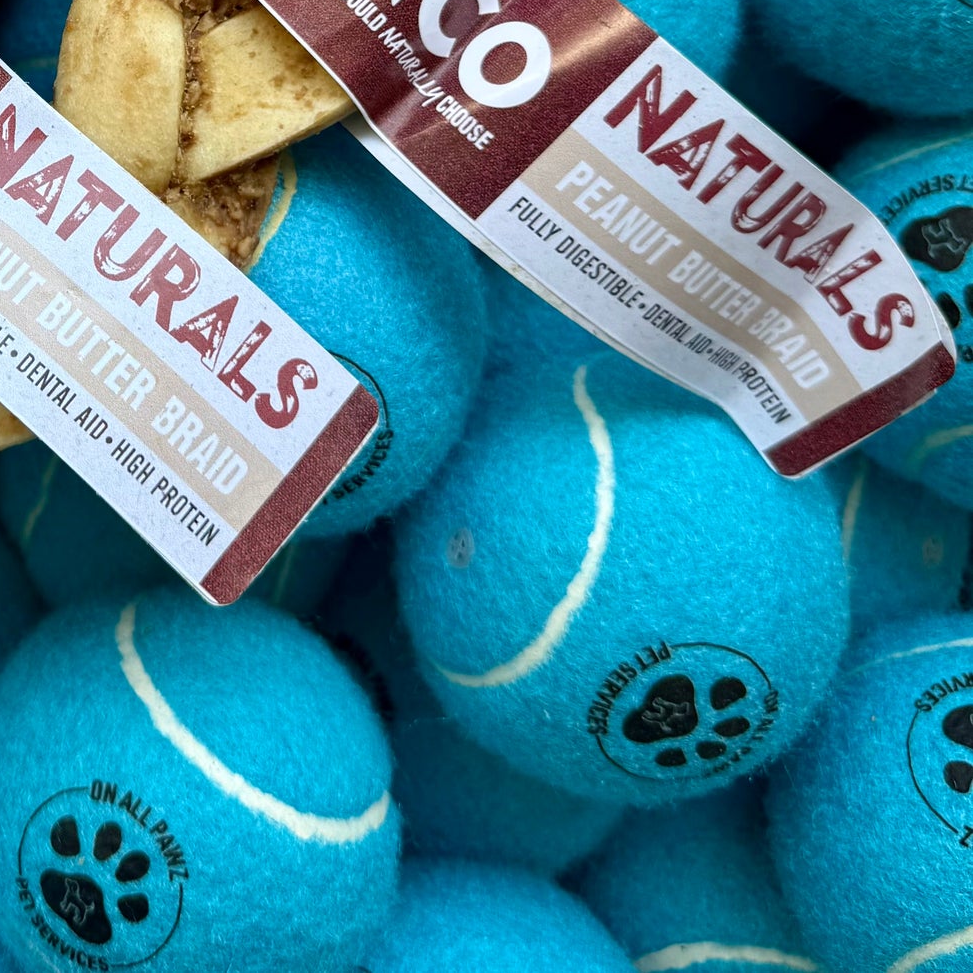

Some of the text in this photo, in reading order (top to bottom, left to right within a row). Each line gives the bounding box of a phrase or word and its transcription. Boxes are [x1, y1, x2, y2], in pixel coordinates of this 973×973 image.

[378, 27, 444, 107] NATURALLY
[436, 95, 496, 151] CHOOSE
[604, 64, 915, 351] NATURALS
[508, 196, 792, 423] FULLY DIGESTIBLE DENTAL AID HIGH PROTEIN
[555, 161, 830, 389] PEANUT BUTTER BRAID
[16, 352, 82, 416] DENTAL
[74, 406, 109, 443] AID
[111, 438, 152, 485] HIGH
[152, 479, 222, 548] PROTEIN
[38, 289, 158, 412] BUTTER
[151, 394, 250, 496] BRAID
[332, 429, 394, 499] SERVICES
[588, 640, 671, 735] PET SERVICES
[914, 672, 973, 712] RVICES
[90, 779, 189, 882] ON ALL PAWZ
[16, 877, 109, 971] PET SERVICES
